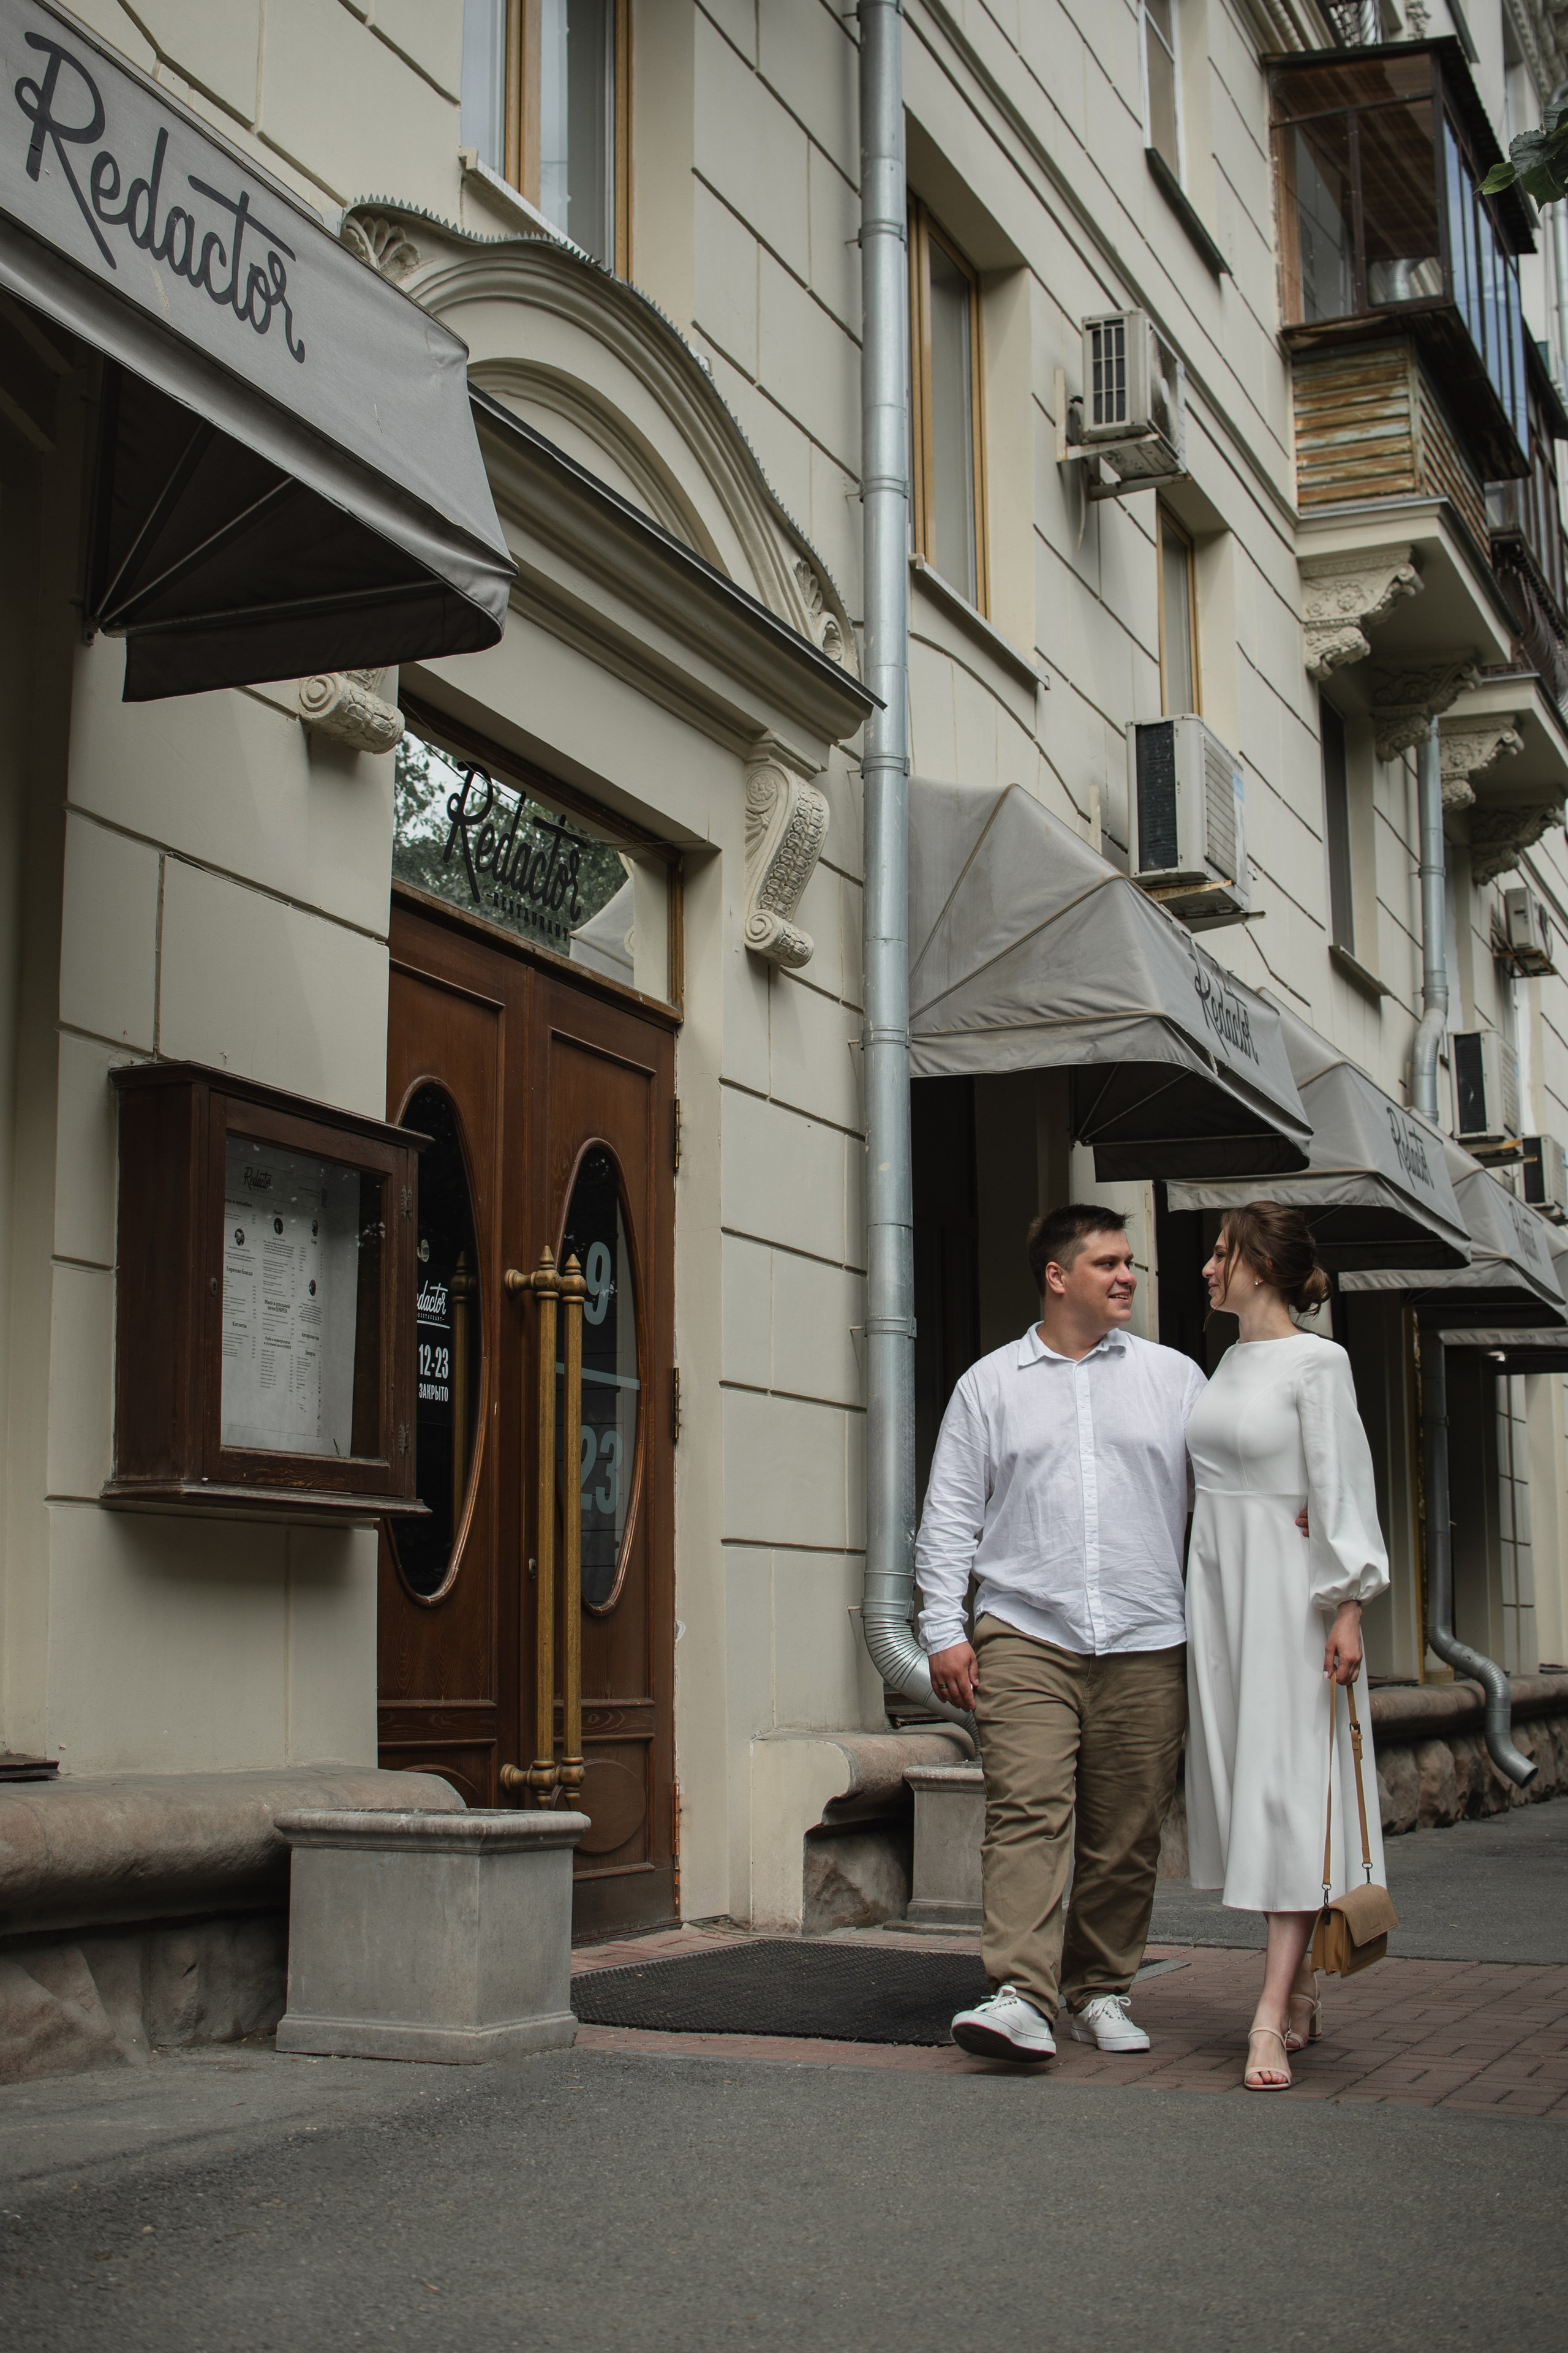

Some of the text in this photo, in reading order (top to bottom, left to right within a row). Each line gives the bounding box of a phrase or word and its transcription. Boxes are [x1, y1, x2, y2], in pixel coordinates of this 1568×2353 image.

[15, 32, 305, 363] Redactor
[443, 761, 588, 922] Redactor
[1187, 953, 1259, 1066] Redactor
[244, 1166, 273, 1191] Redactor
[417, 1280, 448, 1315] dactor
[584, 1241, 611, 1325] 9
[419, 1344, 448, 1379] 12-23
[419, 1383, 448, 1402] ЗАКРЫТО
[581, 1425, 623, 1514] 23
